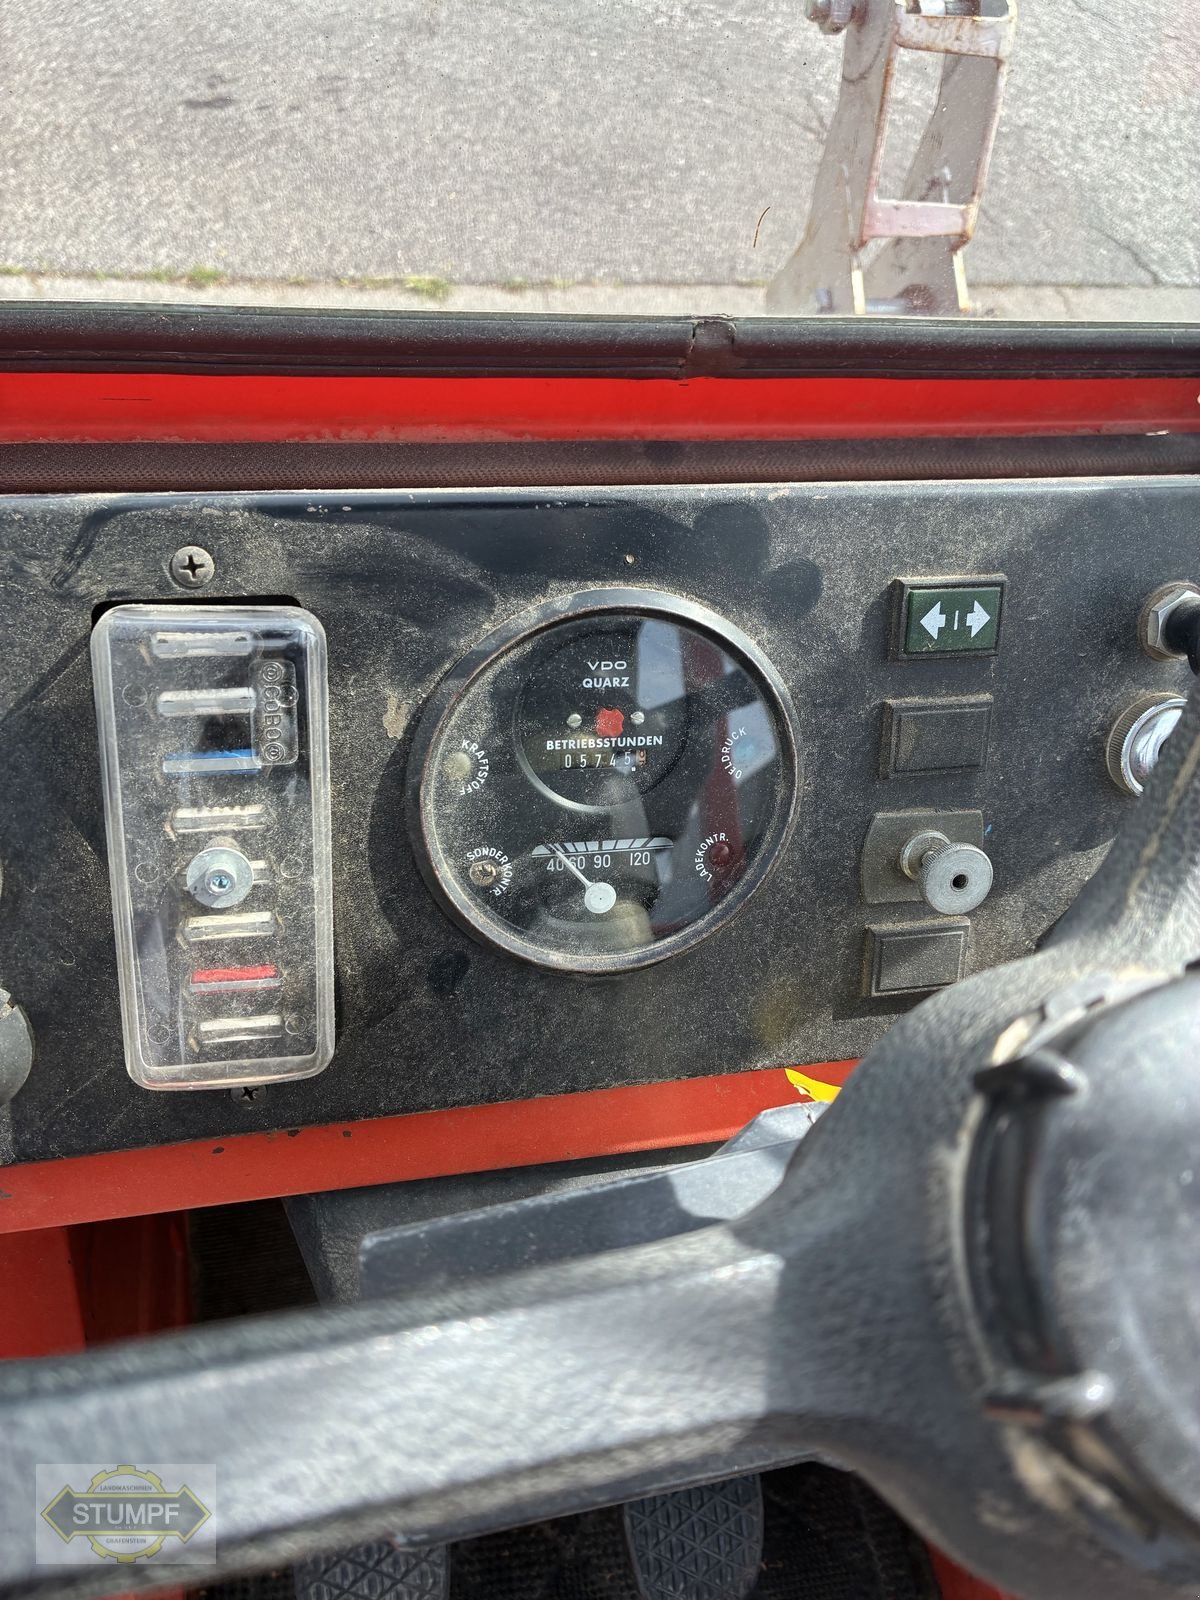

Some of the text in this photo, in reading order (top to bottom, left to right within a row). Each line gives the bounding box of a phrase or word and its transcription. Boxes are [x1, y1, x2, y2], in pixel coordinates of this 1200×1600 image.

[582, 677, 629, 688] QUARZ
[587, 660, 627, 670] VDO
[546, 735, 663, 750] BETRIEBSSTUNDEN
[721, 727, 747, 779] OELDRUCK
[459, 739, 489, 796] KRAFTSTOFF
[466, 847, 513, 896] SONDERKONTR.
[546, 857, 565, 872] 40
[593, 854, 611, 869] 90
[630, 851, 651, 866] 120
[694, 832, 729, 882] LADEKONTR.
